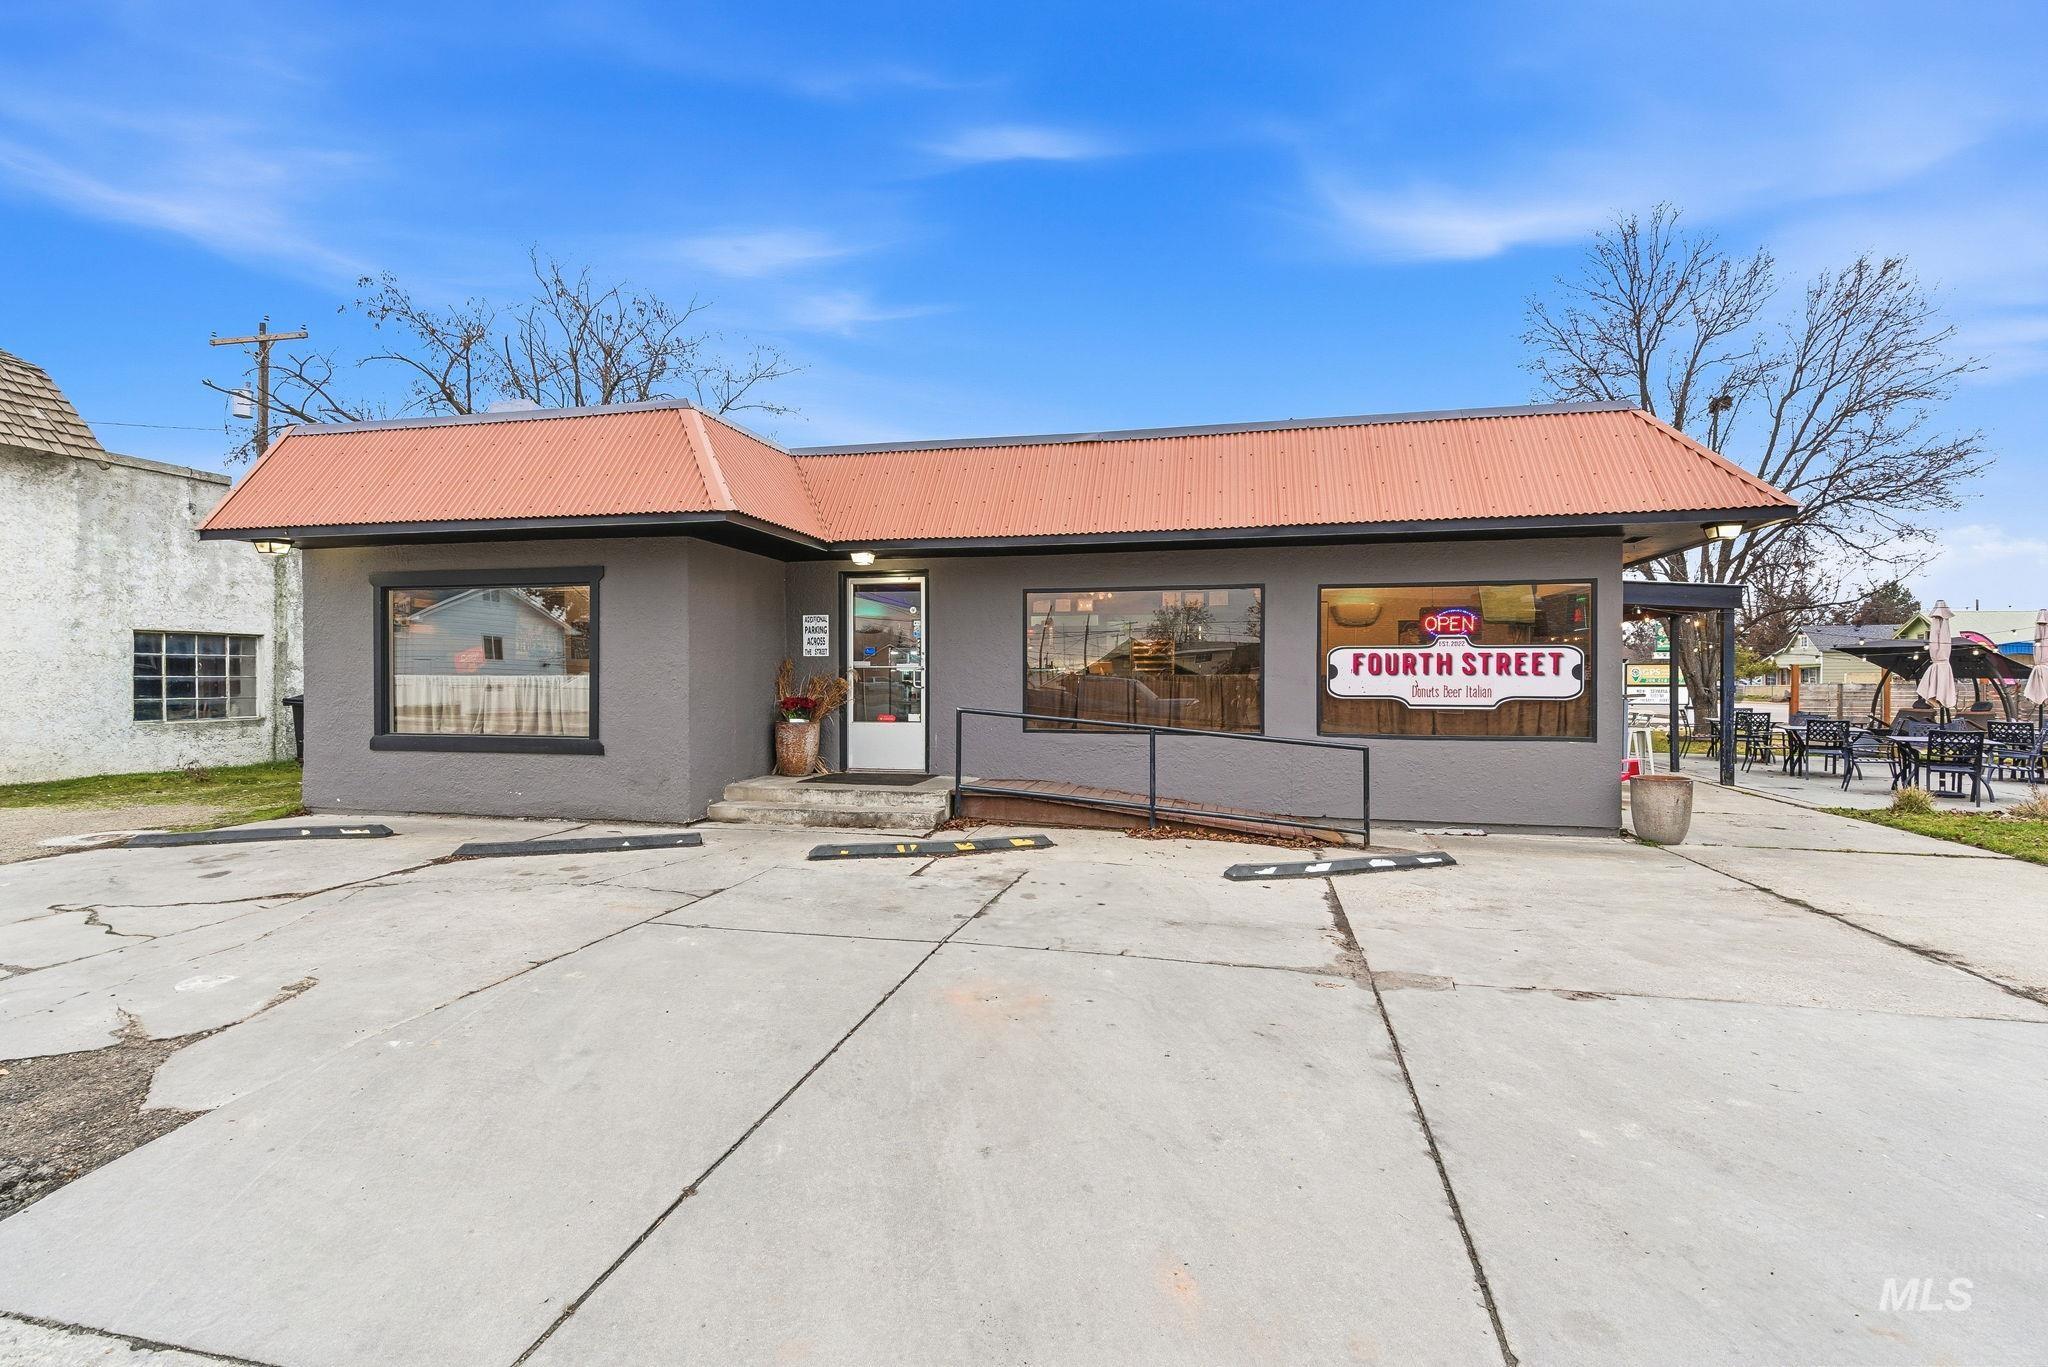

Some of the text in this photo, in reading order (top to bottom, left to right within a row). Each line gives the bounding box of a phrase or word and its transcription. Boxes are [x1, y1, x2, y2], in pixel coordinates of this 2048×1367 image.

[804, 626, 828, 634] PARKING
[1424, 616, 1475, 631] OPEN
[807, 637, 826, 645] ACROSS
[1352, 652, 1454, 677] FOURTH
[1461, 652, 1565, 677] STREET
[1411, 684, 1493, 698] Donuts Beer Italian
